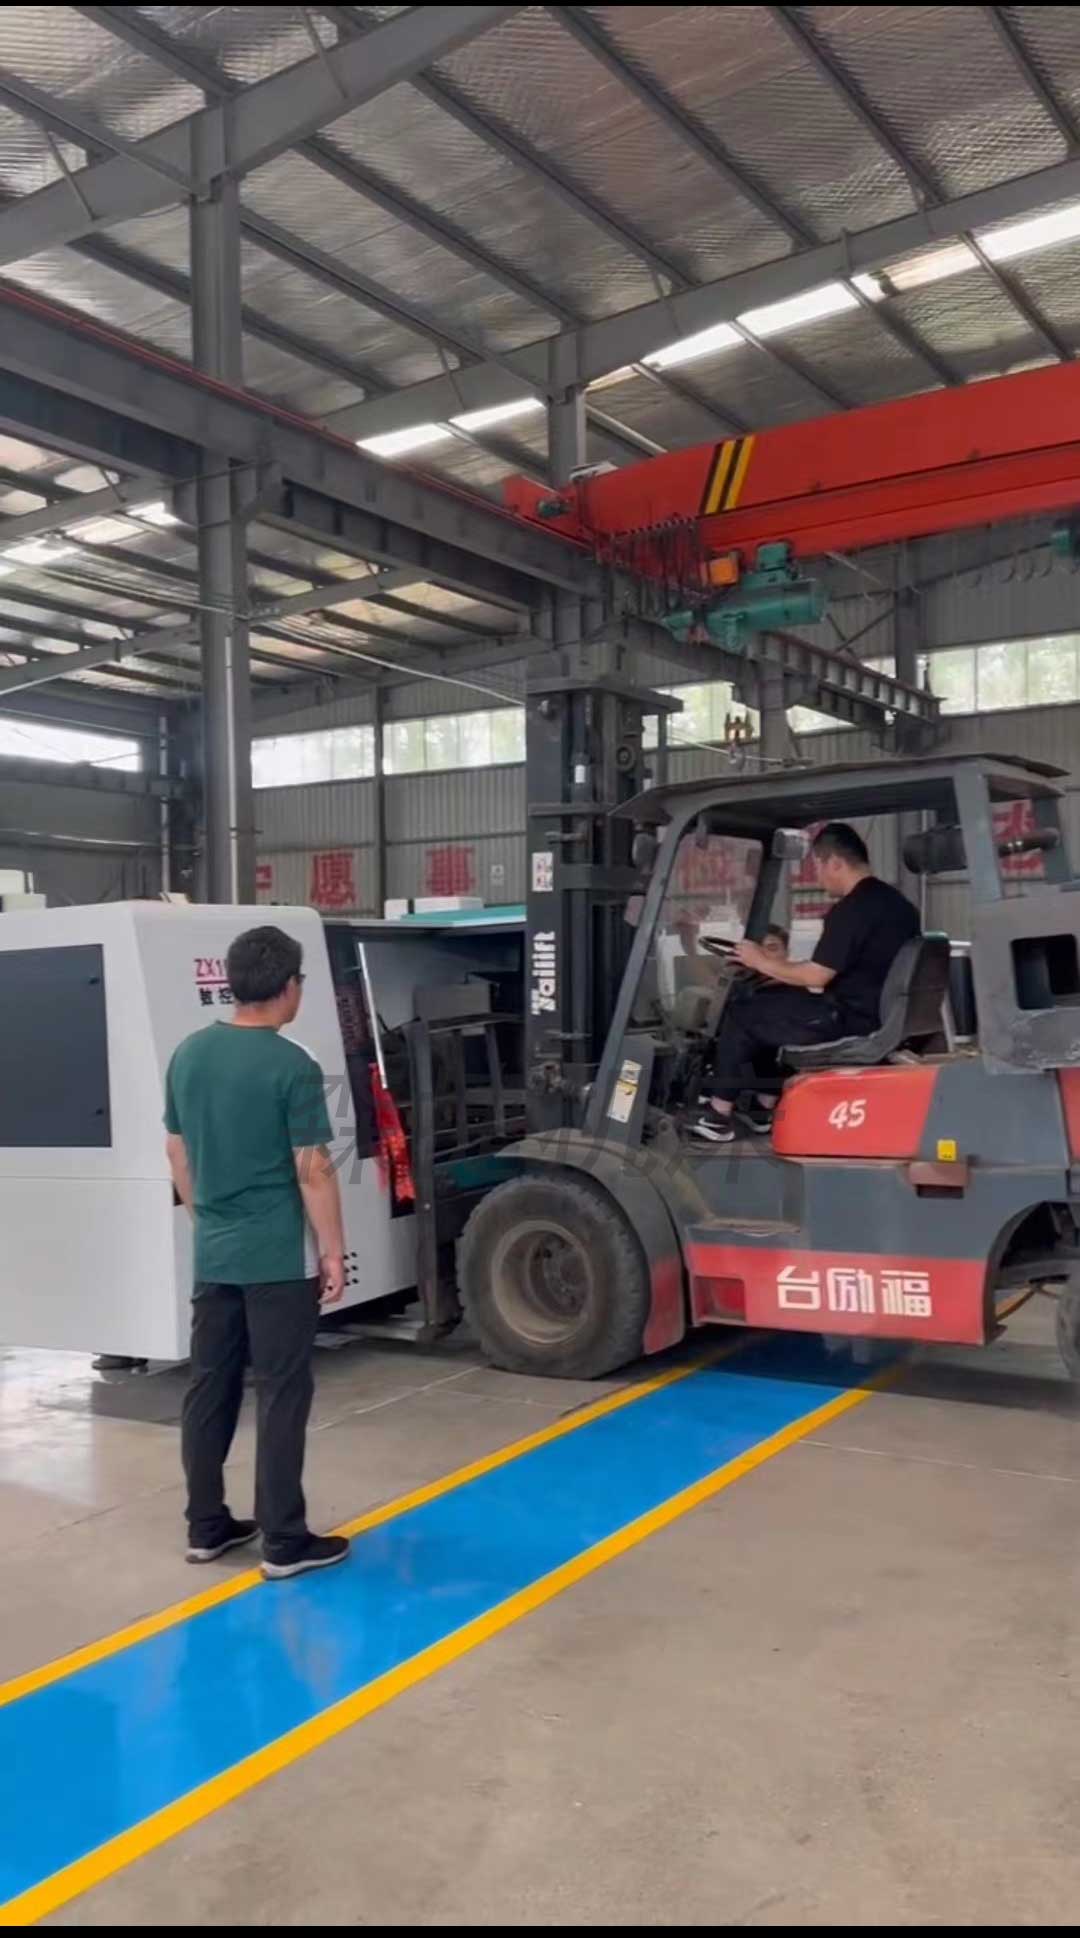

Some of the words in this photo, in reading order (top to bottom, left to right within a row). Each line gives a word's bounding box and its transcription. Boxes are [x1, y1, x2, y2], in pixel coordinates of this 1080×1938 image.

[828, 1099, 867, 1130] 45
[776, 1265, 932, 1317] 台励福
